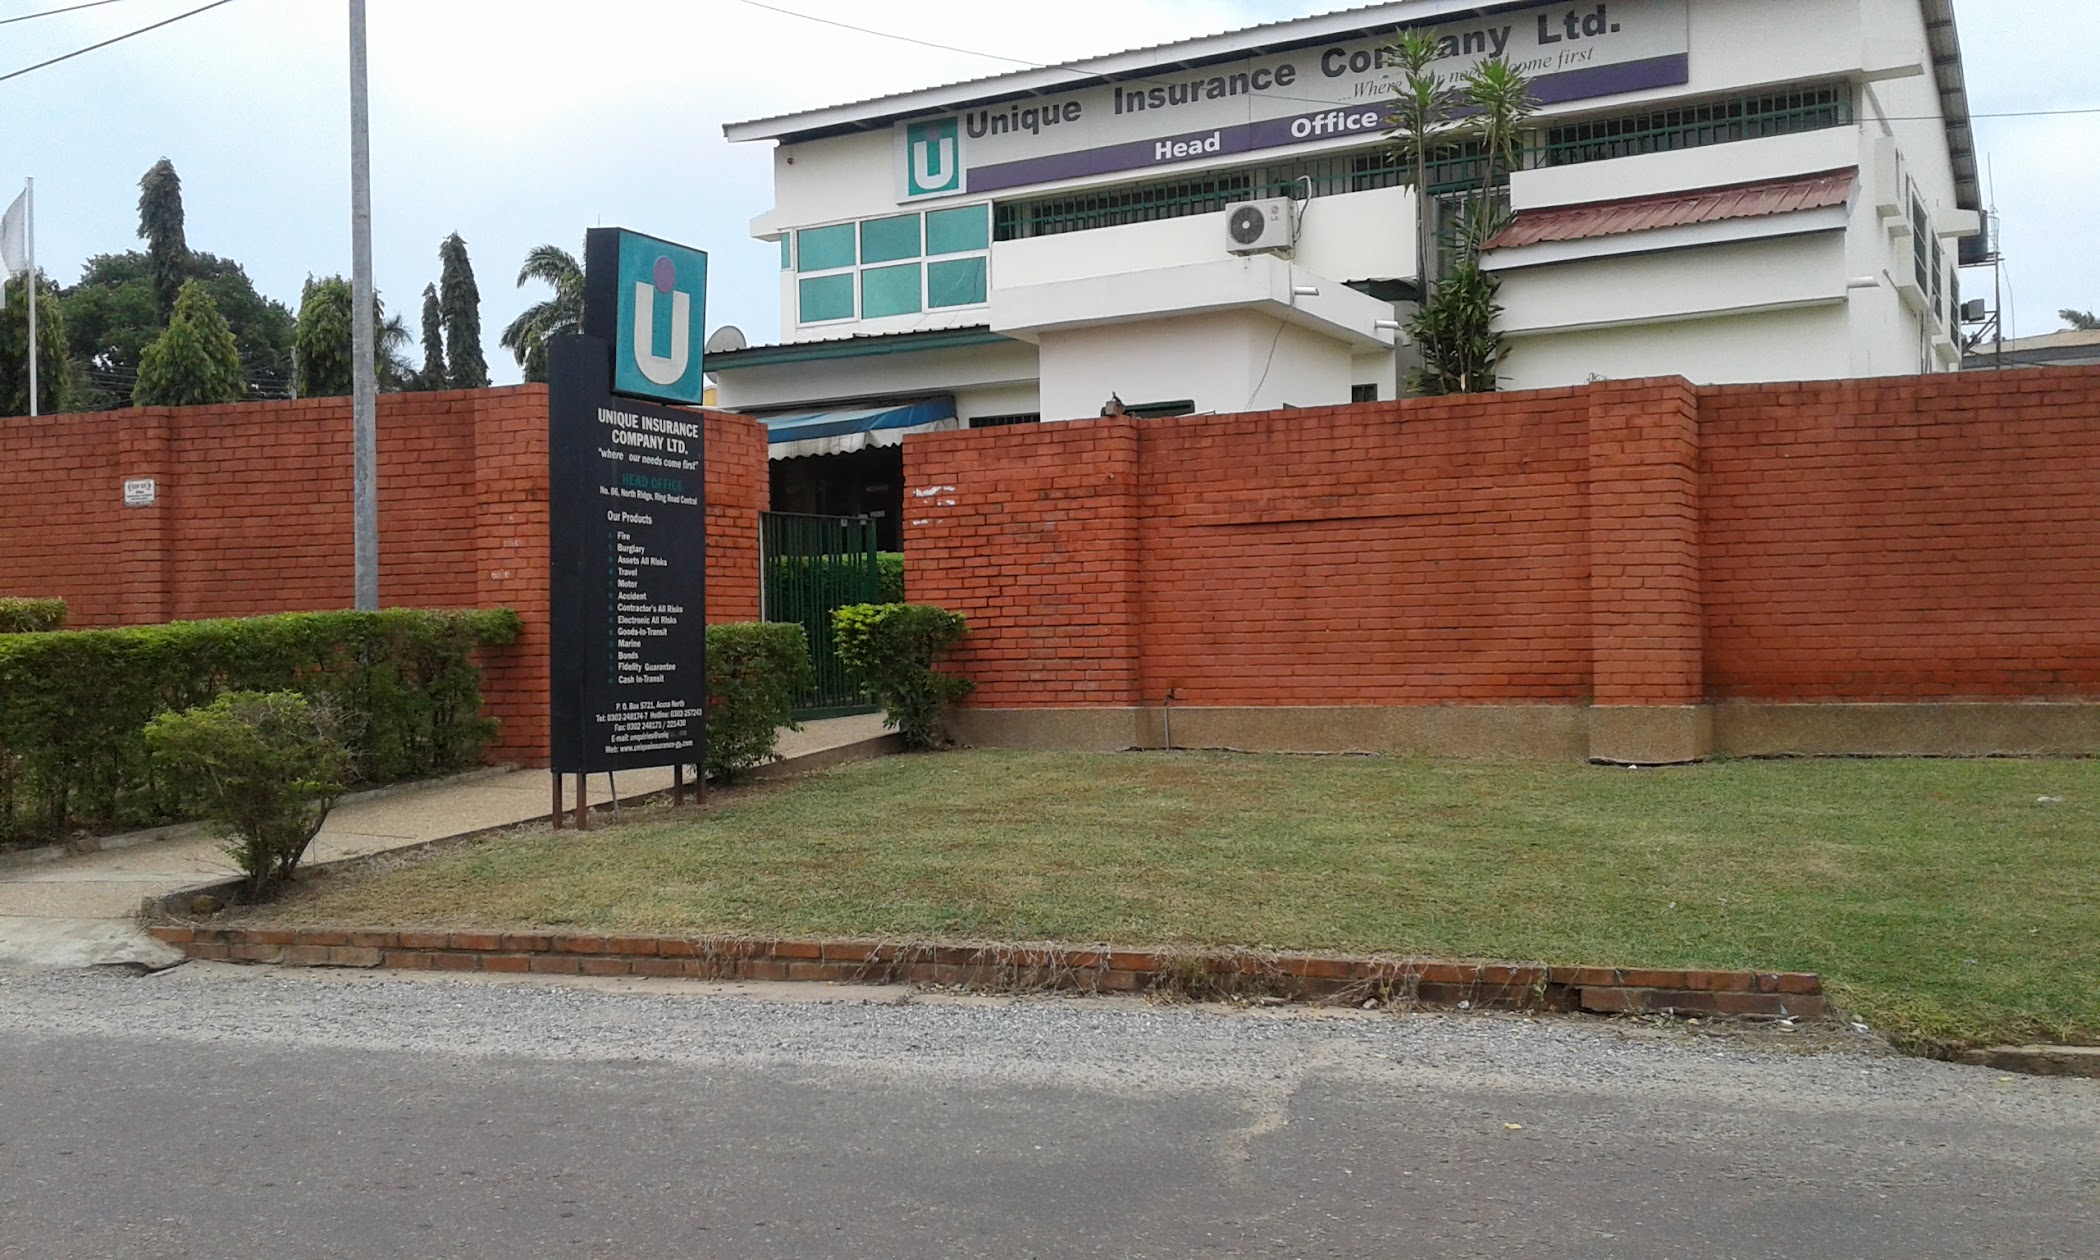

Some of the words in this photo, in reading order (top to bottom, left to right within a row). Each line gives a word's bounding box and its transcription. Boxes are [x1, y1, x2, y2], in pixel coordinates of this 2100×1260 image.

[1556, 46, 1594, 71] first
[966, 100, 1082, 139] Unique
[1114, 63, 1297, 115] Insurance
[1321, 25, 1511, 79] Comany
[1538, 4, 1621, 45] Ltd.
[1155, 131, 1222, 160] Head
[1291, 110, 1379, 139] Office
[598, 407, 639, 429] UNIQUE
[641, 416, 699, 438] INSURANCE
[612, 429, 664, 450] COMPANY
[666, 438, 688, 455] LTD.
[629, 453, 641, 463] our
[642, 455, 662, 466] needs
[664, 459, 681, 469] come
[623, 473, 648, 487] HEAD
[651, 476, 683, 491] OFFICE
[600, 486, 610, 495] No.
[620, 488, 636, 498] North
[654, 492, 667, 504] Ring
[667, 493, 680, 504] Road
[680, 495, 698, 506] Central
[607, 510, 621, 521] Our
[622, 511, 653, 524] Products
[617, 531, 631, 540] Fire
[617, 543, 645, 554] Burglary
[618, 555, 639, 565] Assets
[640, 557, 650, 565] All
[650, 557, 668, 566] Risks
[618, 567, 638, 576] Travel
[617, 579, 638, 588] Motor
[618, 591, 647, 600] Accident
[617, 603, 657, 612] Contractor's
[658, 604, 666, 613] All
[667, 605, 683, 613] Risks
[617, 616, 650, 624] Electronic
[651, 616, 660, 624] All
[660, 616, 677, 624] Risks
[618, 639, 641, 647] Marine
[618, 651, 639, 660] Bonds
[618, 662, 642, 673] Fidelity
[644, 663, 676, 671] Guarantee
[618, 675, 635, 684] Cash
[636, 674, 665, 683] In-Transit
[629, 702, 639, 710] Box
[656, 700, 671, 708] Accra
[671, 699, 685, 708] North
